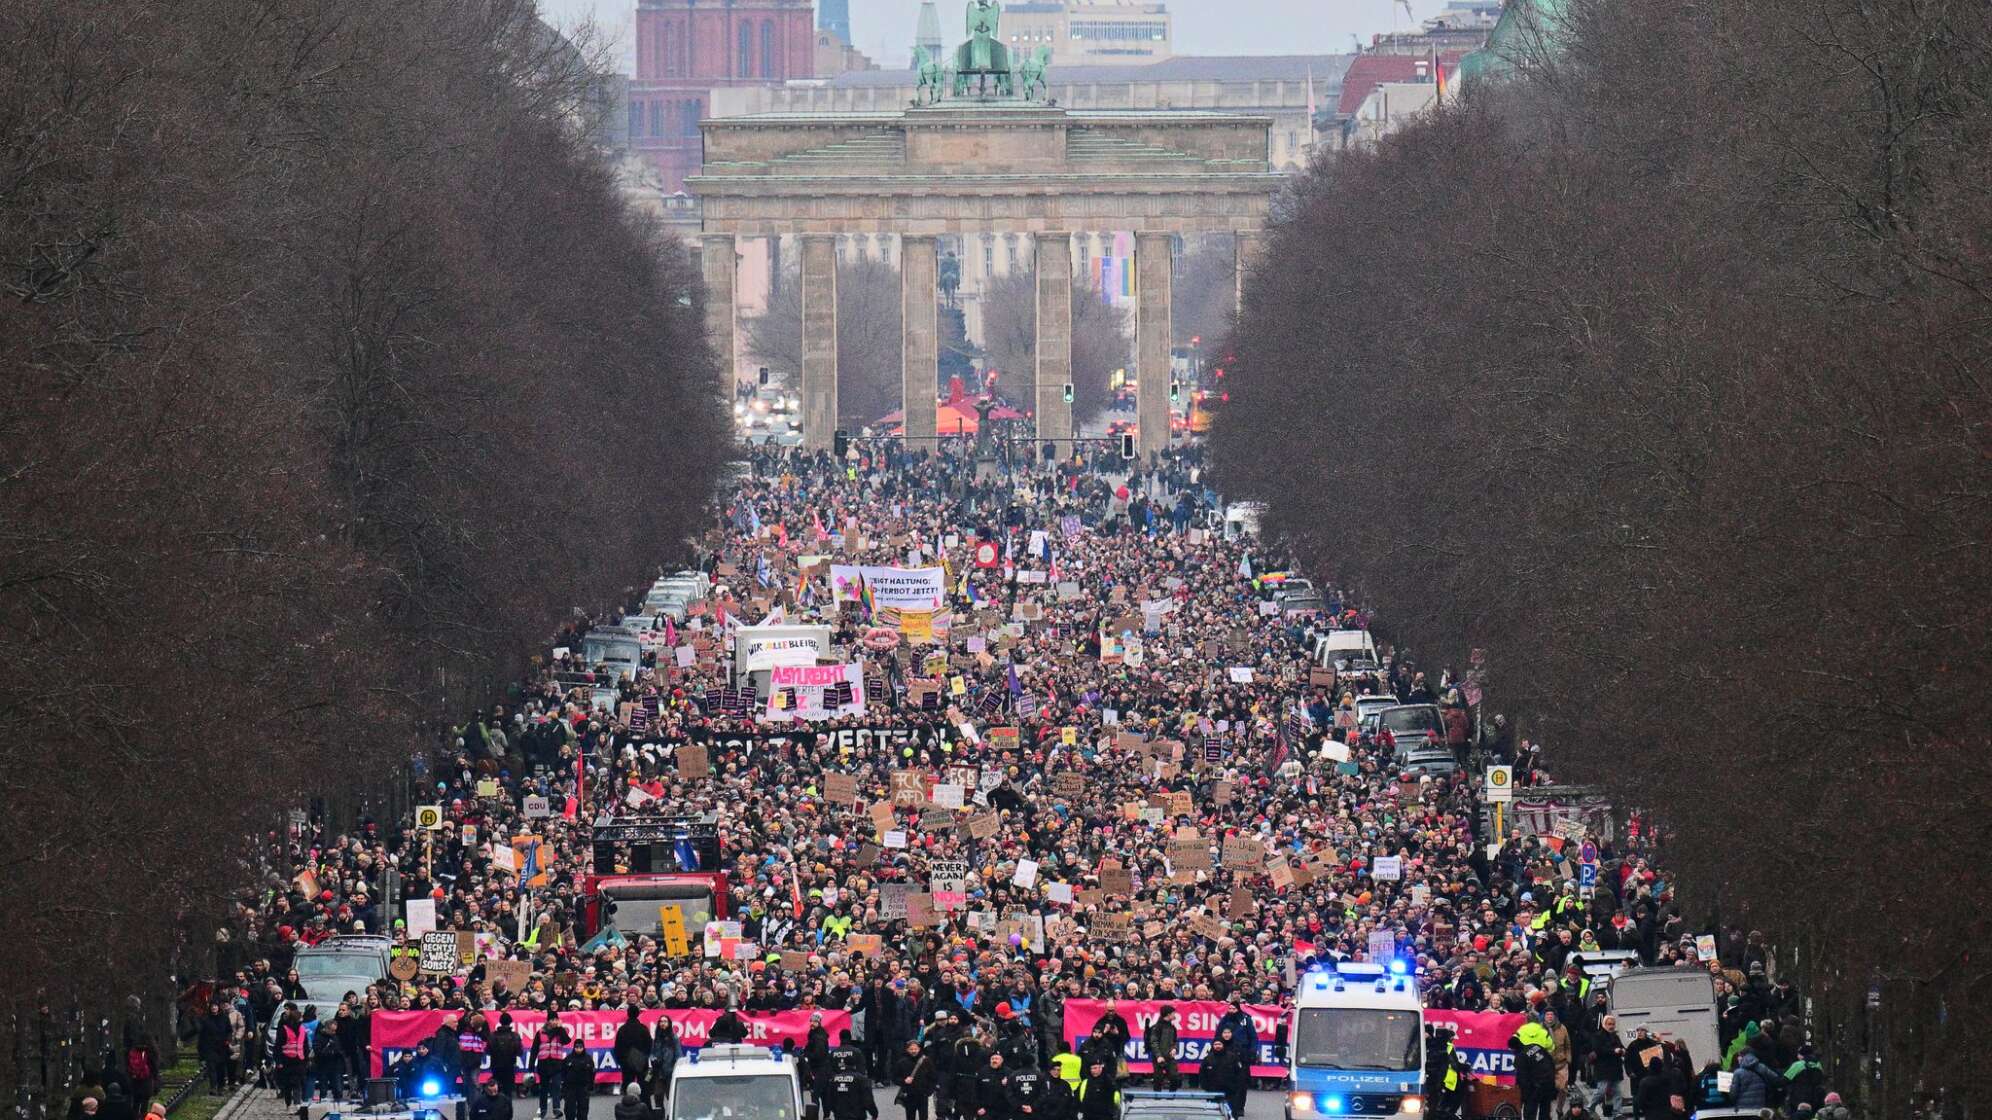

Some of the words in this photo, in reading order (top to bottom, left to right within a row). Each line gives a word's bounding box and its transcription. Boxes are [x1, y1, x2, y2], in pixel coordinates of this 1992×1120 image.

[890, 577, 931, 585] HALTUNG:
[912, 587, 938, 595] JETZT!
[748, 641, 763, 655] WIR
[771, 664, 846, 685] ASYLRECHT
[950, 767, 976, 783] FCK
[893, 772, 923, 790] FCK
[895, 789, 924, 803] AFD
[425, 812, 433, 822] H
[933, 863, 962, 872] NEVER
[1583, 866, 1590, 880] P
[943, 882, 953, 891] IS
[424, 933, 455, 943] GEGEN
[423, 943, 456, 956] RECHTS!
[429, 951, 449, 960] WAS
[1136, 1012, 1182, 1031] WR
[1472, 1052, 1516, 1071] AFD
[1015, 1074, 1037, 1082] POLIZEI
[1327, 1075, 1390, 1083] POLIZEI
